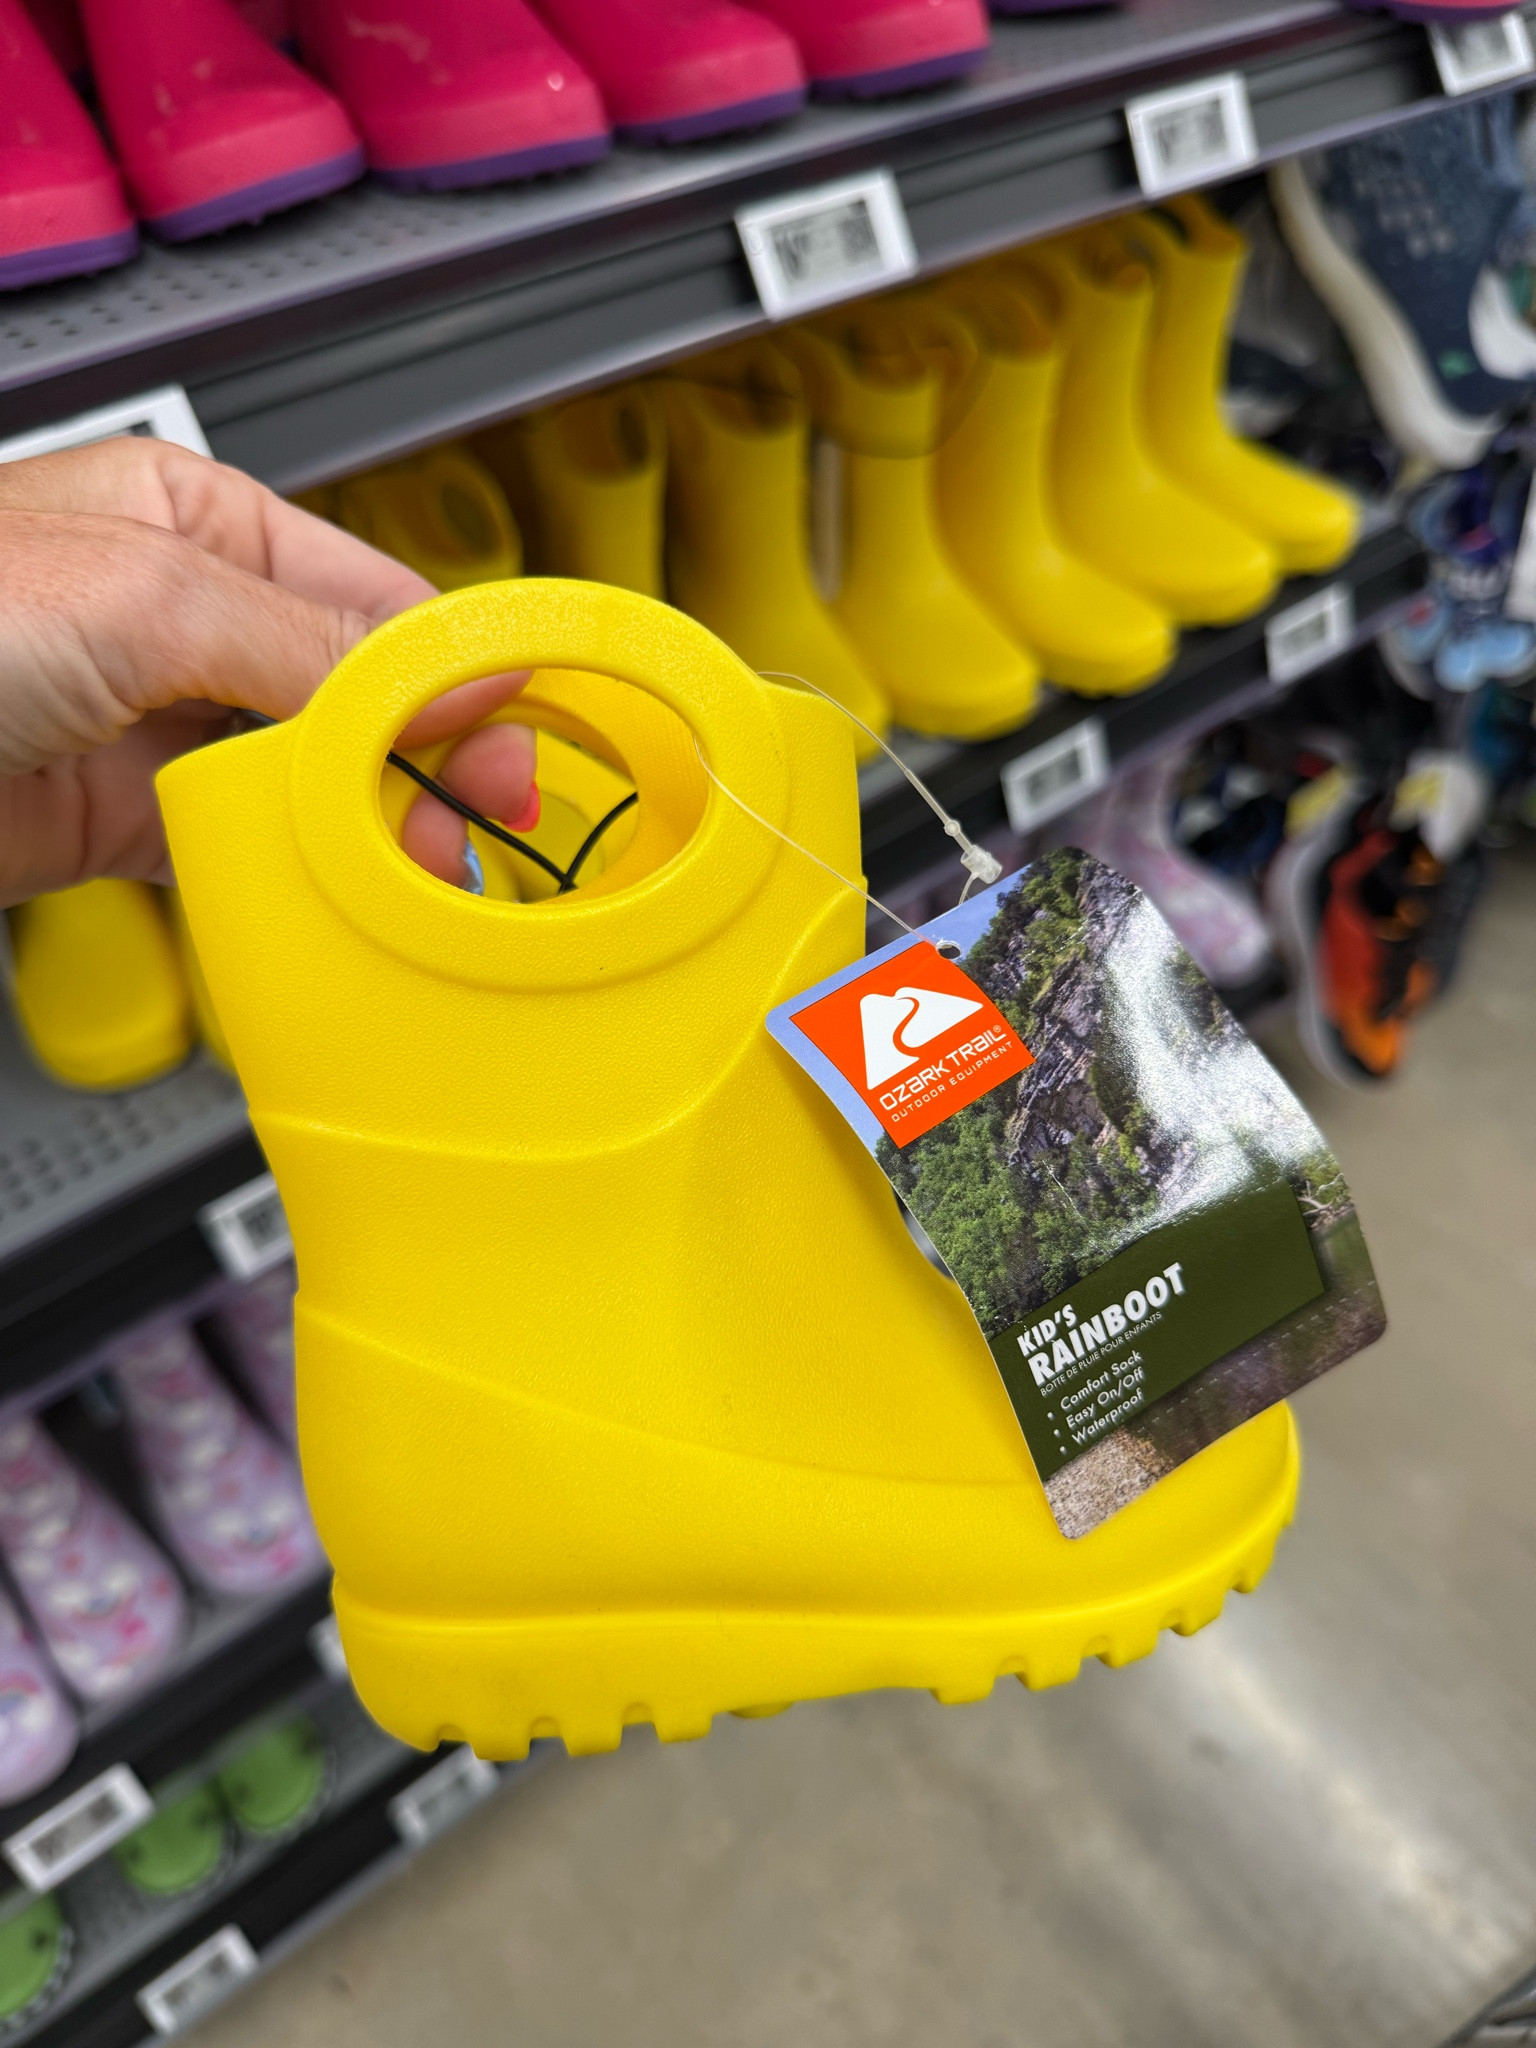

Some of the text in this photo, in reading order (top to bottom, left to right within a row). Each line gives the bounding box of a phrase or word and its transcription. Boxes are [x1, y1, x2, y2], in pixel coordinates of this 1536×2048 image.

[891, 1041, 1013, 1123] OUTDOOR EQUIPMENT
[1016, 1303, 1077, 1357] KID'S
[1027, 1262, 1185, 1387] RAINBOOT
[1040, 1311, 1163, 1397] BOTTE DE PLUIE POUR ENFANTS
[1060, 1350, 1143, 1411] Comfort Sock
[1066, 1366, 1145, 1429] Easy On/Off
[1071, 1387, 1144, 1445] Waterproof
